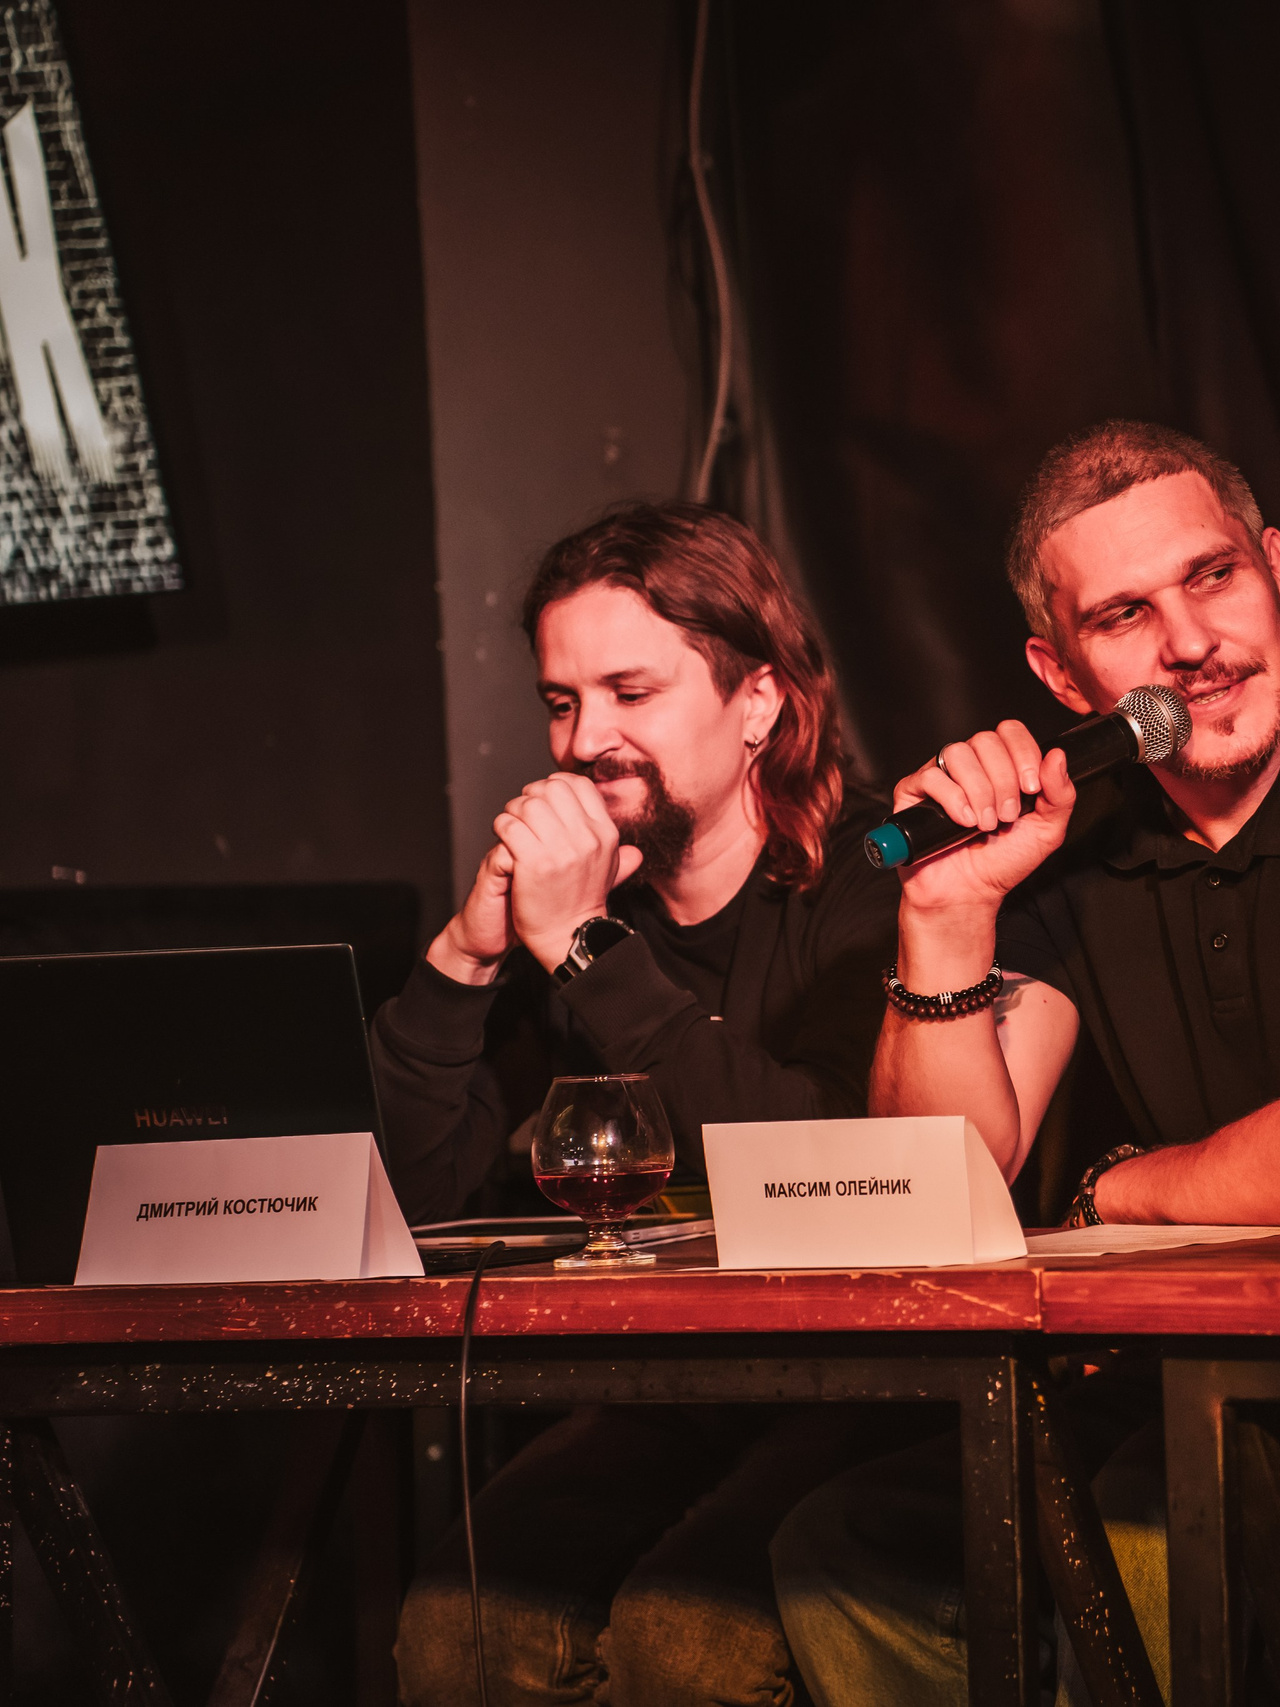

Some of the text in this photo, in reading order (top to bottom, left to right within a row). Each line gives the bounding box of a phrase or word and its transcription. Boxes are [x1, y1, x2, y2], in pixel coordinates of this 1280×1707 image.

[764, 1177, 912, 1199] МАКСИМ ОЛЕЙНИК
[136, 1196, 320, 1222] ДМИТРИЙ КОСТЮЧИК
